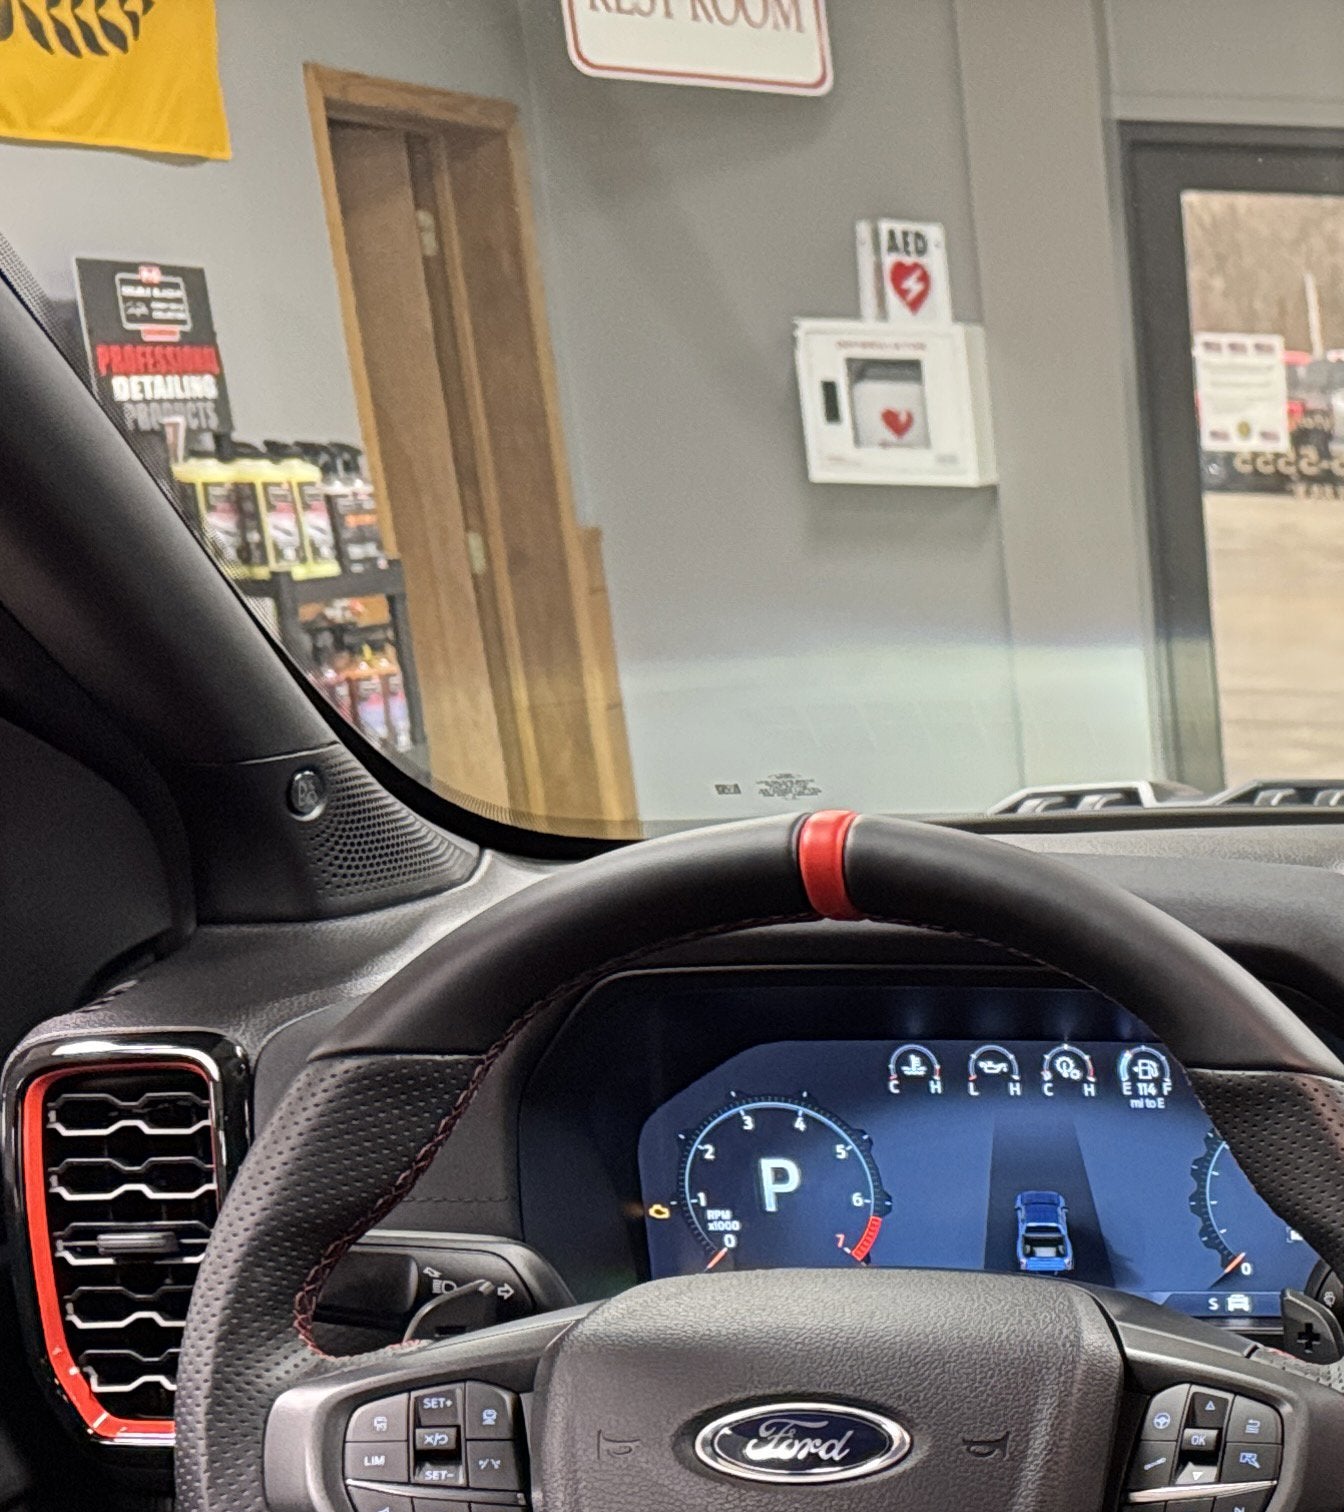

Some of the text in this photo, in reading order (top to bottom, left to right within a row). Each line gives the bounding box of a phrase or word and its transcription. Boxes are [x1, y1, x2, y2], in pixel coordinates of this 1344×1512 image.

[886, 228, 929, 258] AED
[96, 344, 220, 376] PROFESSIONAL
[111, 374, 219, 402] DETAILING
[888, 1079, 900, 1094] C
[930, 1080, 943, 1095] H
[968, 1081, 980, 1096] L
[1009, 1082, 1021, 1097] H
[1043, 1082, 1054, 1097] C
[1083, 1082, 1096, 1097] H
[1122, 1081, 1132, 1096] E
[1136, 1082, 1157, 1097] 114
[1162, 1080, 1173, 1095] F
[742, 1115, 754, 1131] 3
[794, 1116, 806, 1132] 4
[703, 1144, 715, 1160] 2
[835, 1144, 848, 1160] 5
[760, 1157, 800, 1212] P
[697, 1192, 707, 1207] 1
[852, 1192, 864, 1207] 6
[706, 1209, 732, 1220] RPM
[723, 1233, 737, 1248] 0
[835, 1233, 845, 1248] 7
[1240, 1262, 1252, 1276] 0
[1208, 1297, 1219, 1311] S
[744, 1418, 854, 1461] Ford
[1190, 1435, 1207, 1446] OK
[363, 1455, 386, 1467] LIM
